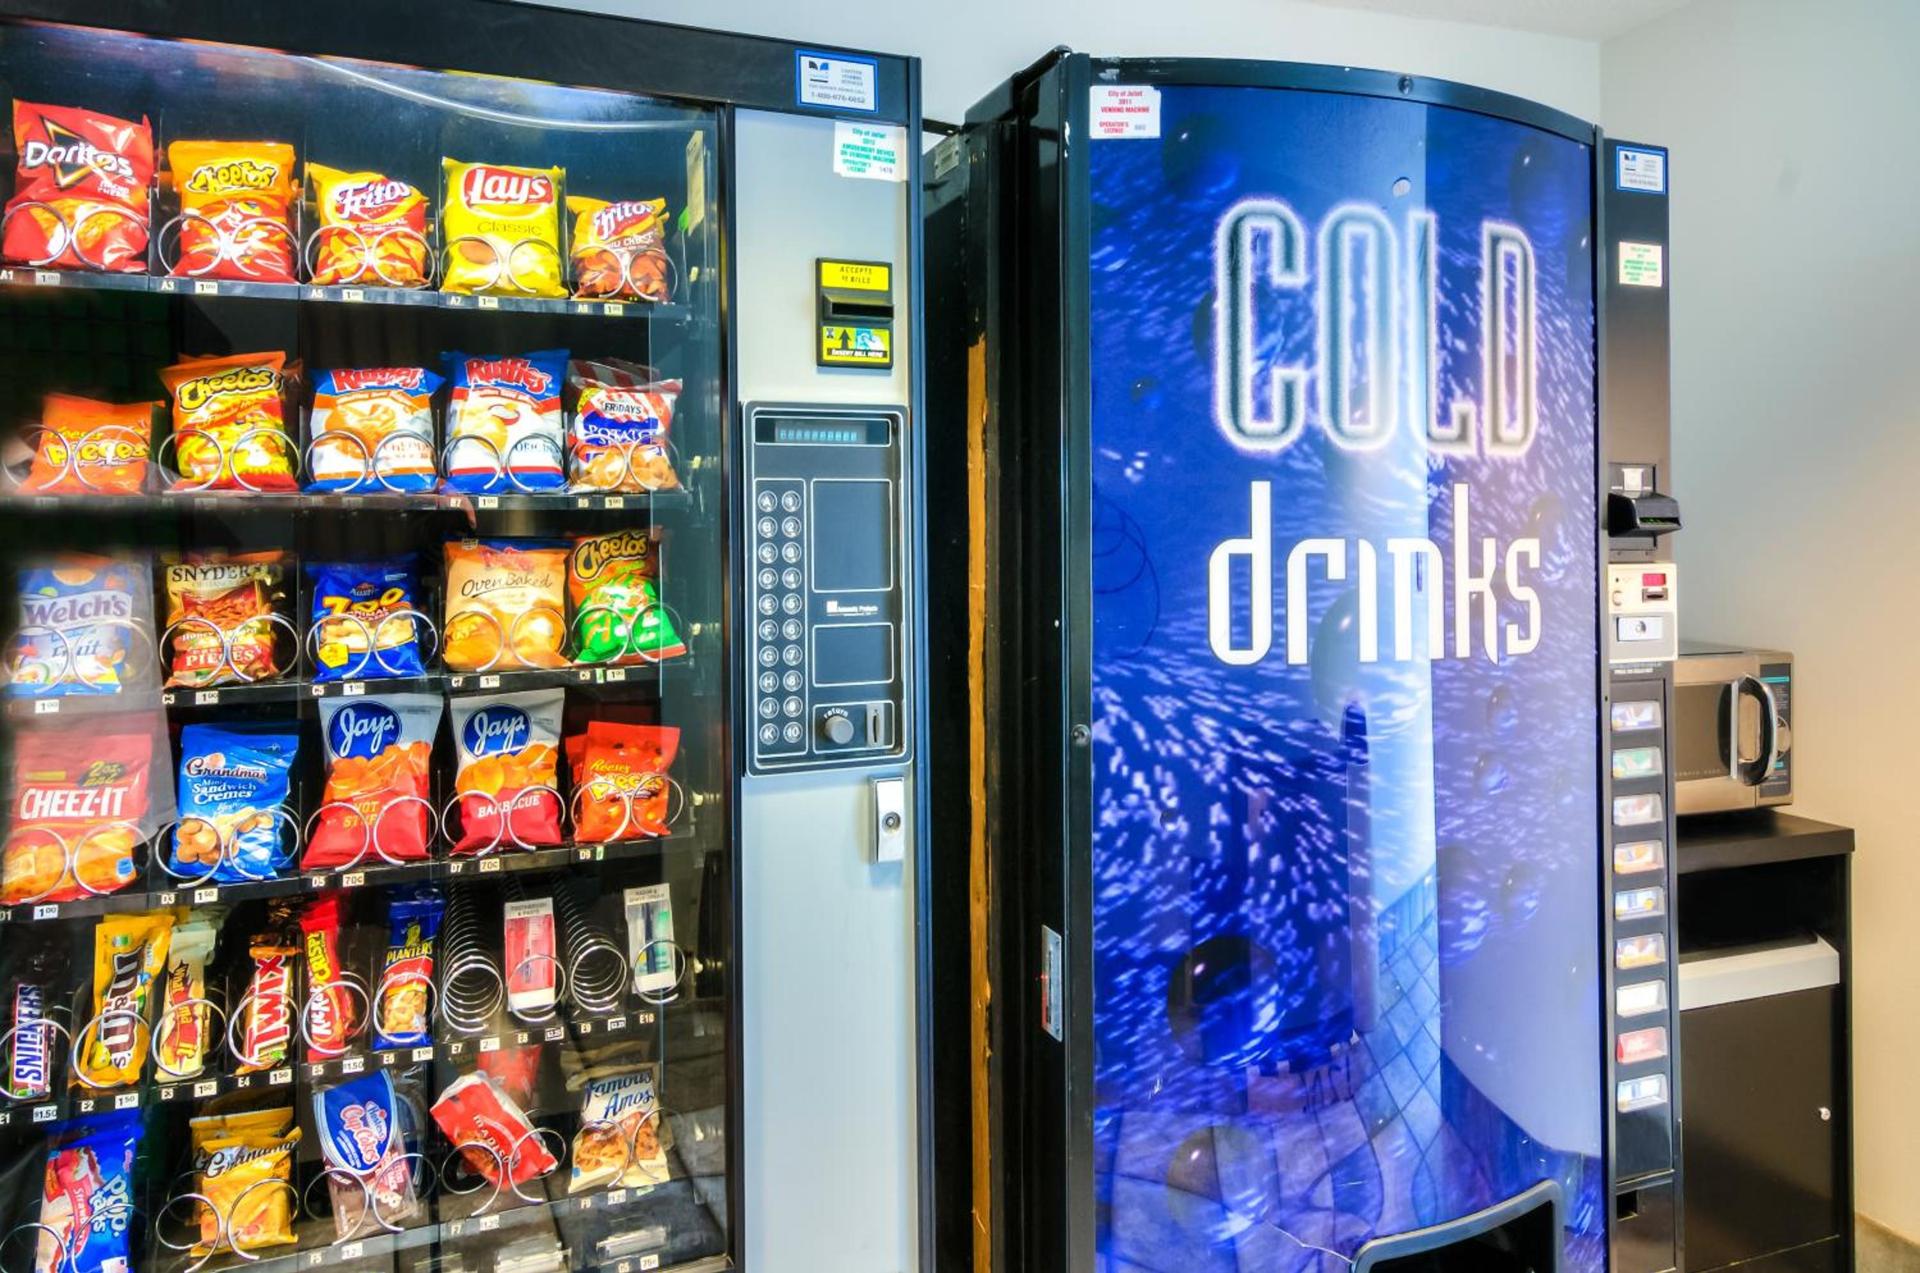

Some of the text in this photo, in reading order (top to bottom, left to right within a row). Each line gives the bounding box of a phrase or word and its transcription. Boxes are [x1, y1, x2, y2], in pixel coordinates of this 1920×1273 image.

[26, 141, 134, 177] Doritos
[336, 181, 411, 219] Fritos
[477, 219, 543, 236] Classic
[1213, 199, 1539, 456] COLD
[180, 368, 272, 410] Cheetos
[575, 533, 648, 579] Cheetos
[1209, 480, 1542, 666] drinks
[505, 572, 553, 589] Baked
[24, 594, 129, 626] Welch's
[823, 708, 849, 719] return
[19, 786, 128, 819] CHEEZ-IT
[192, 782, 257, 794] Sandwich
[194, 789, 253, 805] Cremes
[247, 955, 290, 1063] TWIX
[15, 985, 44, 1082] SNICKERS
[586, 1071, 653, 1110] Famous
[603, 1088, 656, 1119] Amos
